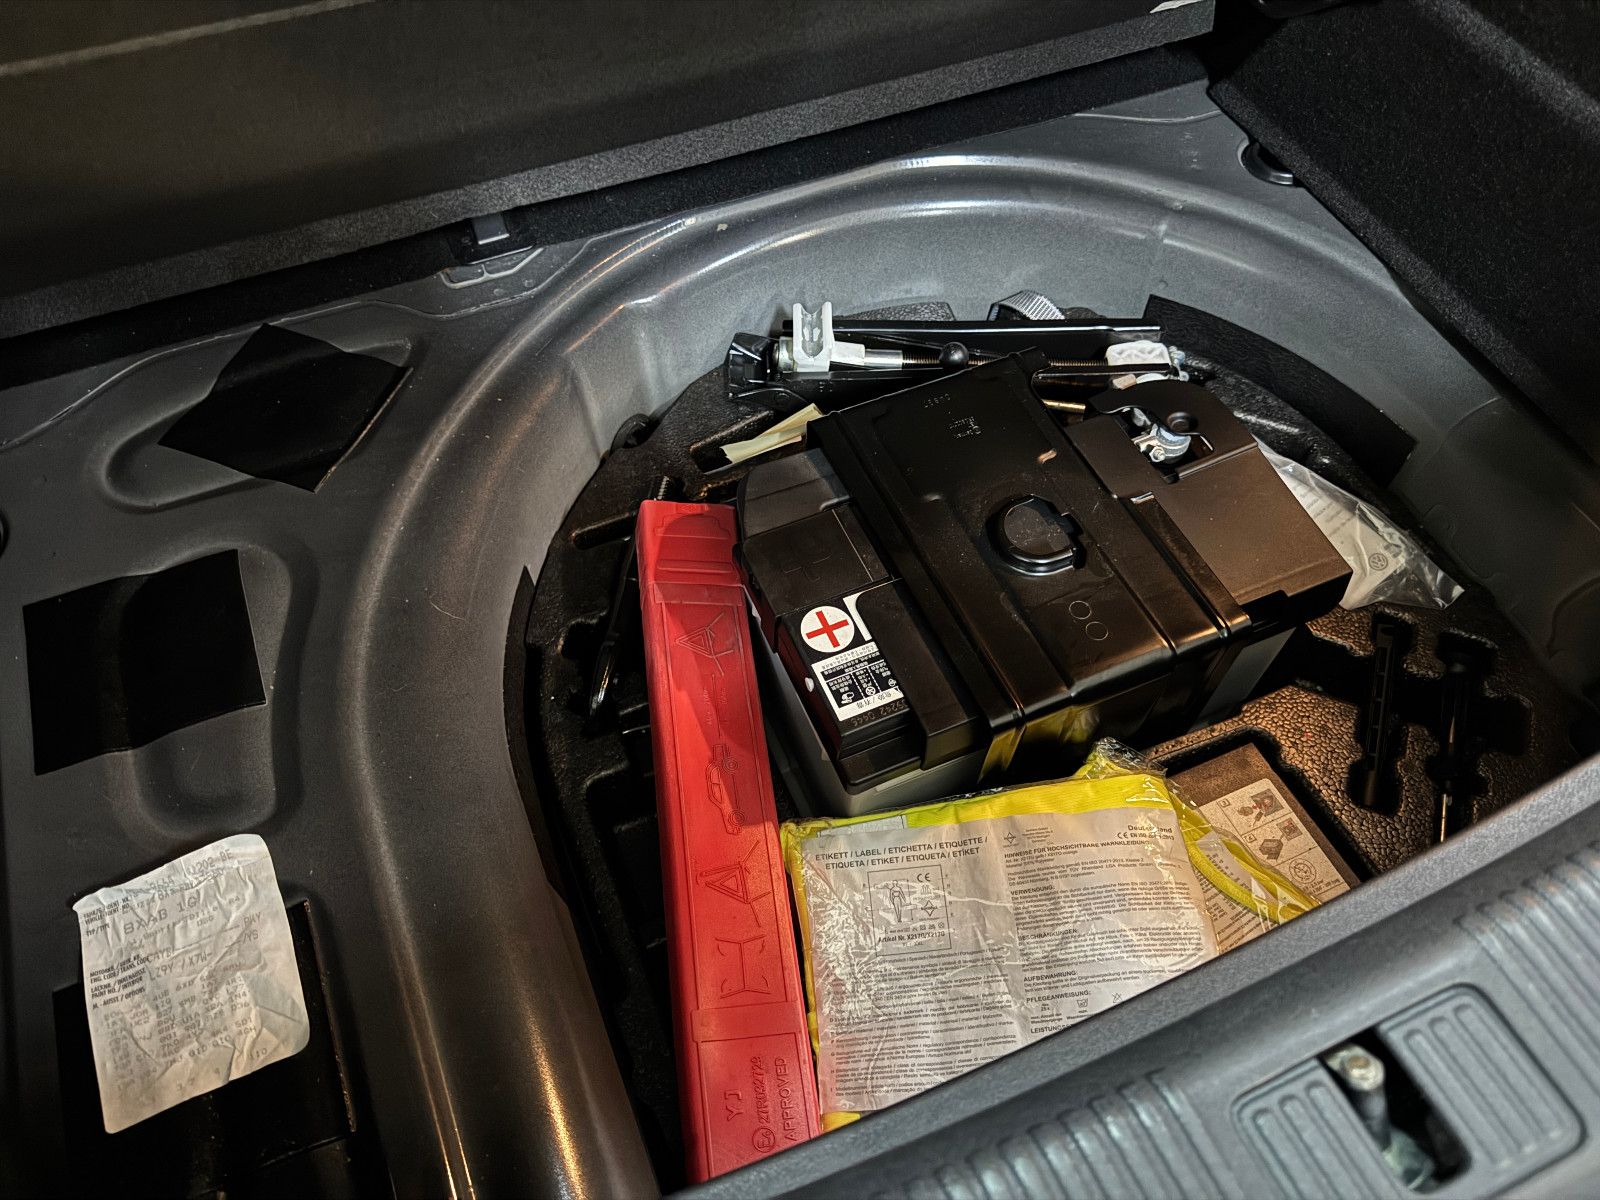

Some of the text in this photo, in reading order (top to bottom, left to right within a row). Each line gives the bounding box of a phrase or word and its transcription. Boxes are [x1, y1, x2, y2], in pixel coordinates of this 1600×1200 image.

[815, 851, 848, 860] ETIKETT
[854, 848, 881, 857] LABEL
[888, 843, 931, 853] ETICHETTA
[938, 837, 984, 848] ETIQUETTE
[1004, 849, 1032, 858] HINWEISE
[1046, 844, 1098, 852] HOCHSICHTBARE
[825, 860, 864, 870] ETIQUETA
[871, 856, 899, 865] ETIKET
[906, 852, 946, 861] ETIQUETA
[1010, 885, 1055, 895] VERWENDUNG:
[1023, 971, 1078, 982] AUFBEWAHRUNG:
[1025, 990, 1091, 1002] PFLEGEANWEISUNG:
[773, 1056, 797, 1142] APPROVED
